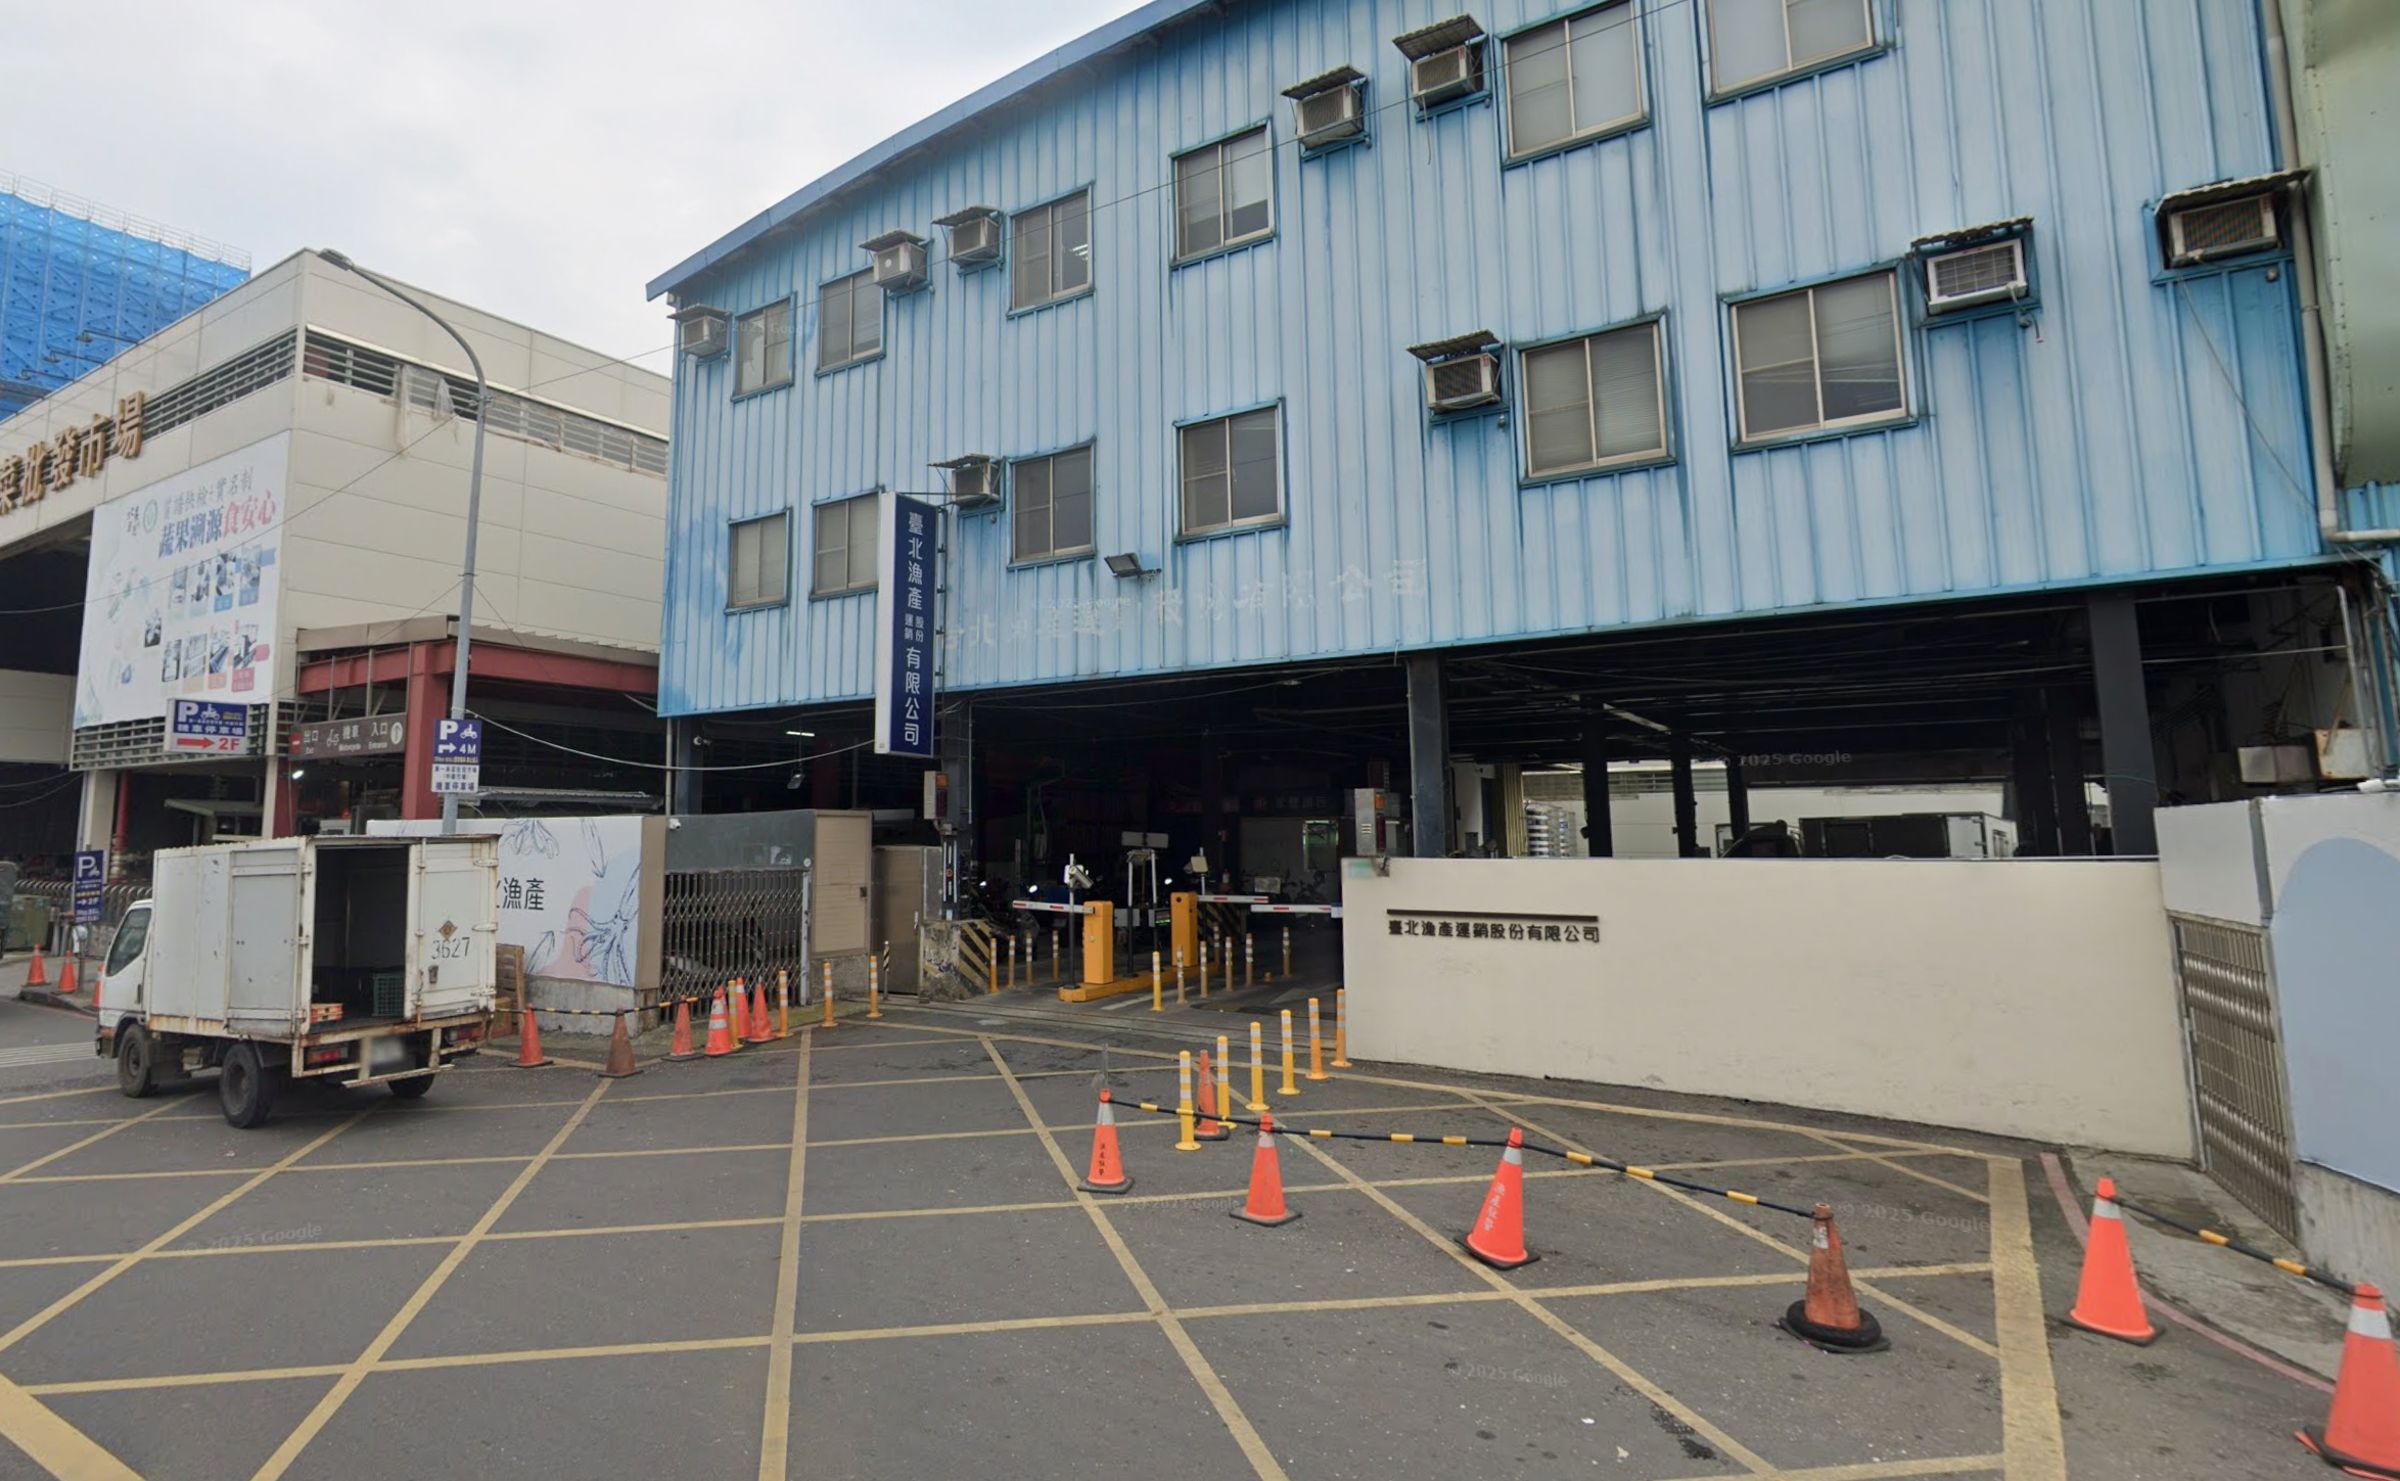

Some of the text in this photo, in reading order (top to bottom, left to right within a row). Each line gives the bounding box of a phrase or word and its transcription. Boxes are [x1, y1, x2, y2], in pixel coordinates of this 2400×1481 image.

[178, 702, 199, 722] P
[303, 729, 319, 744] 出口
[371, 722, 388, 736] 入口
[440, 720, 459, 740] P
[218, 737, 240, 751] 2F
[78, 856, 96, 878] P
[496, 876, 545, 911] 漁產
[1388, 919, 1600, 943] 臺北漁產運銷股份有限公司
[431, 937, 471, 960] 3627
